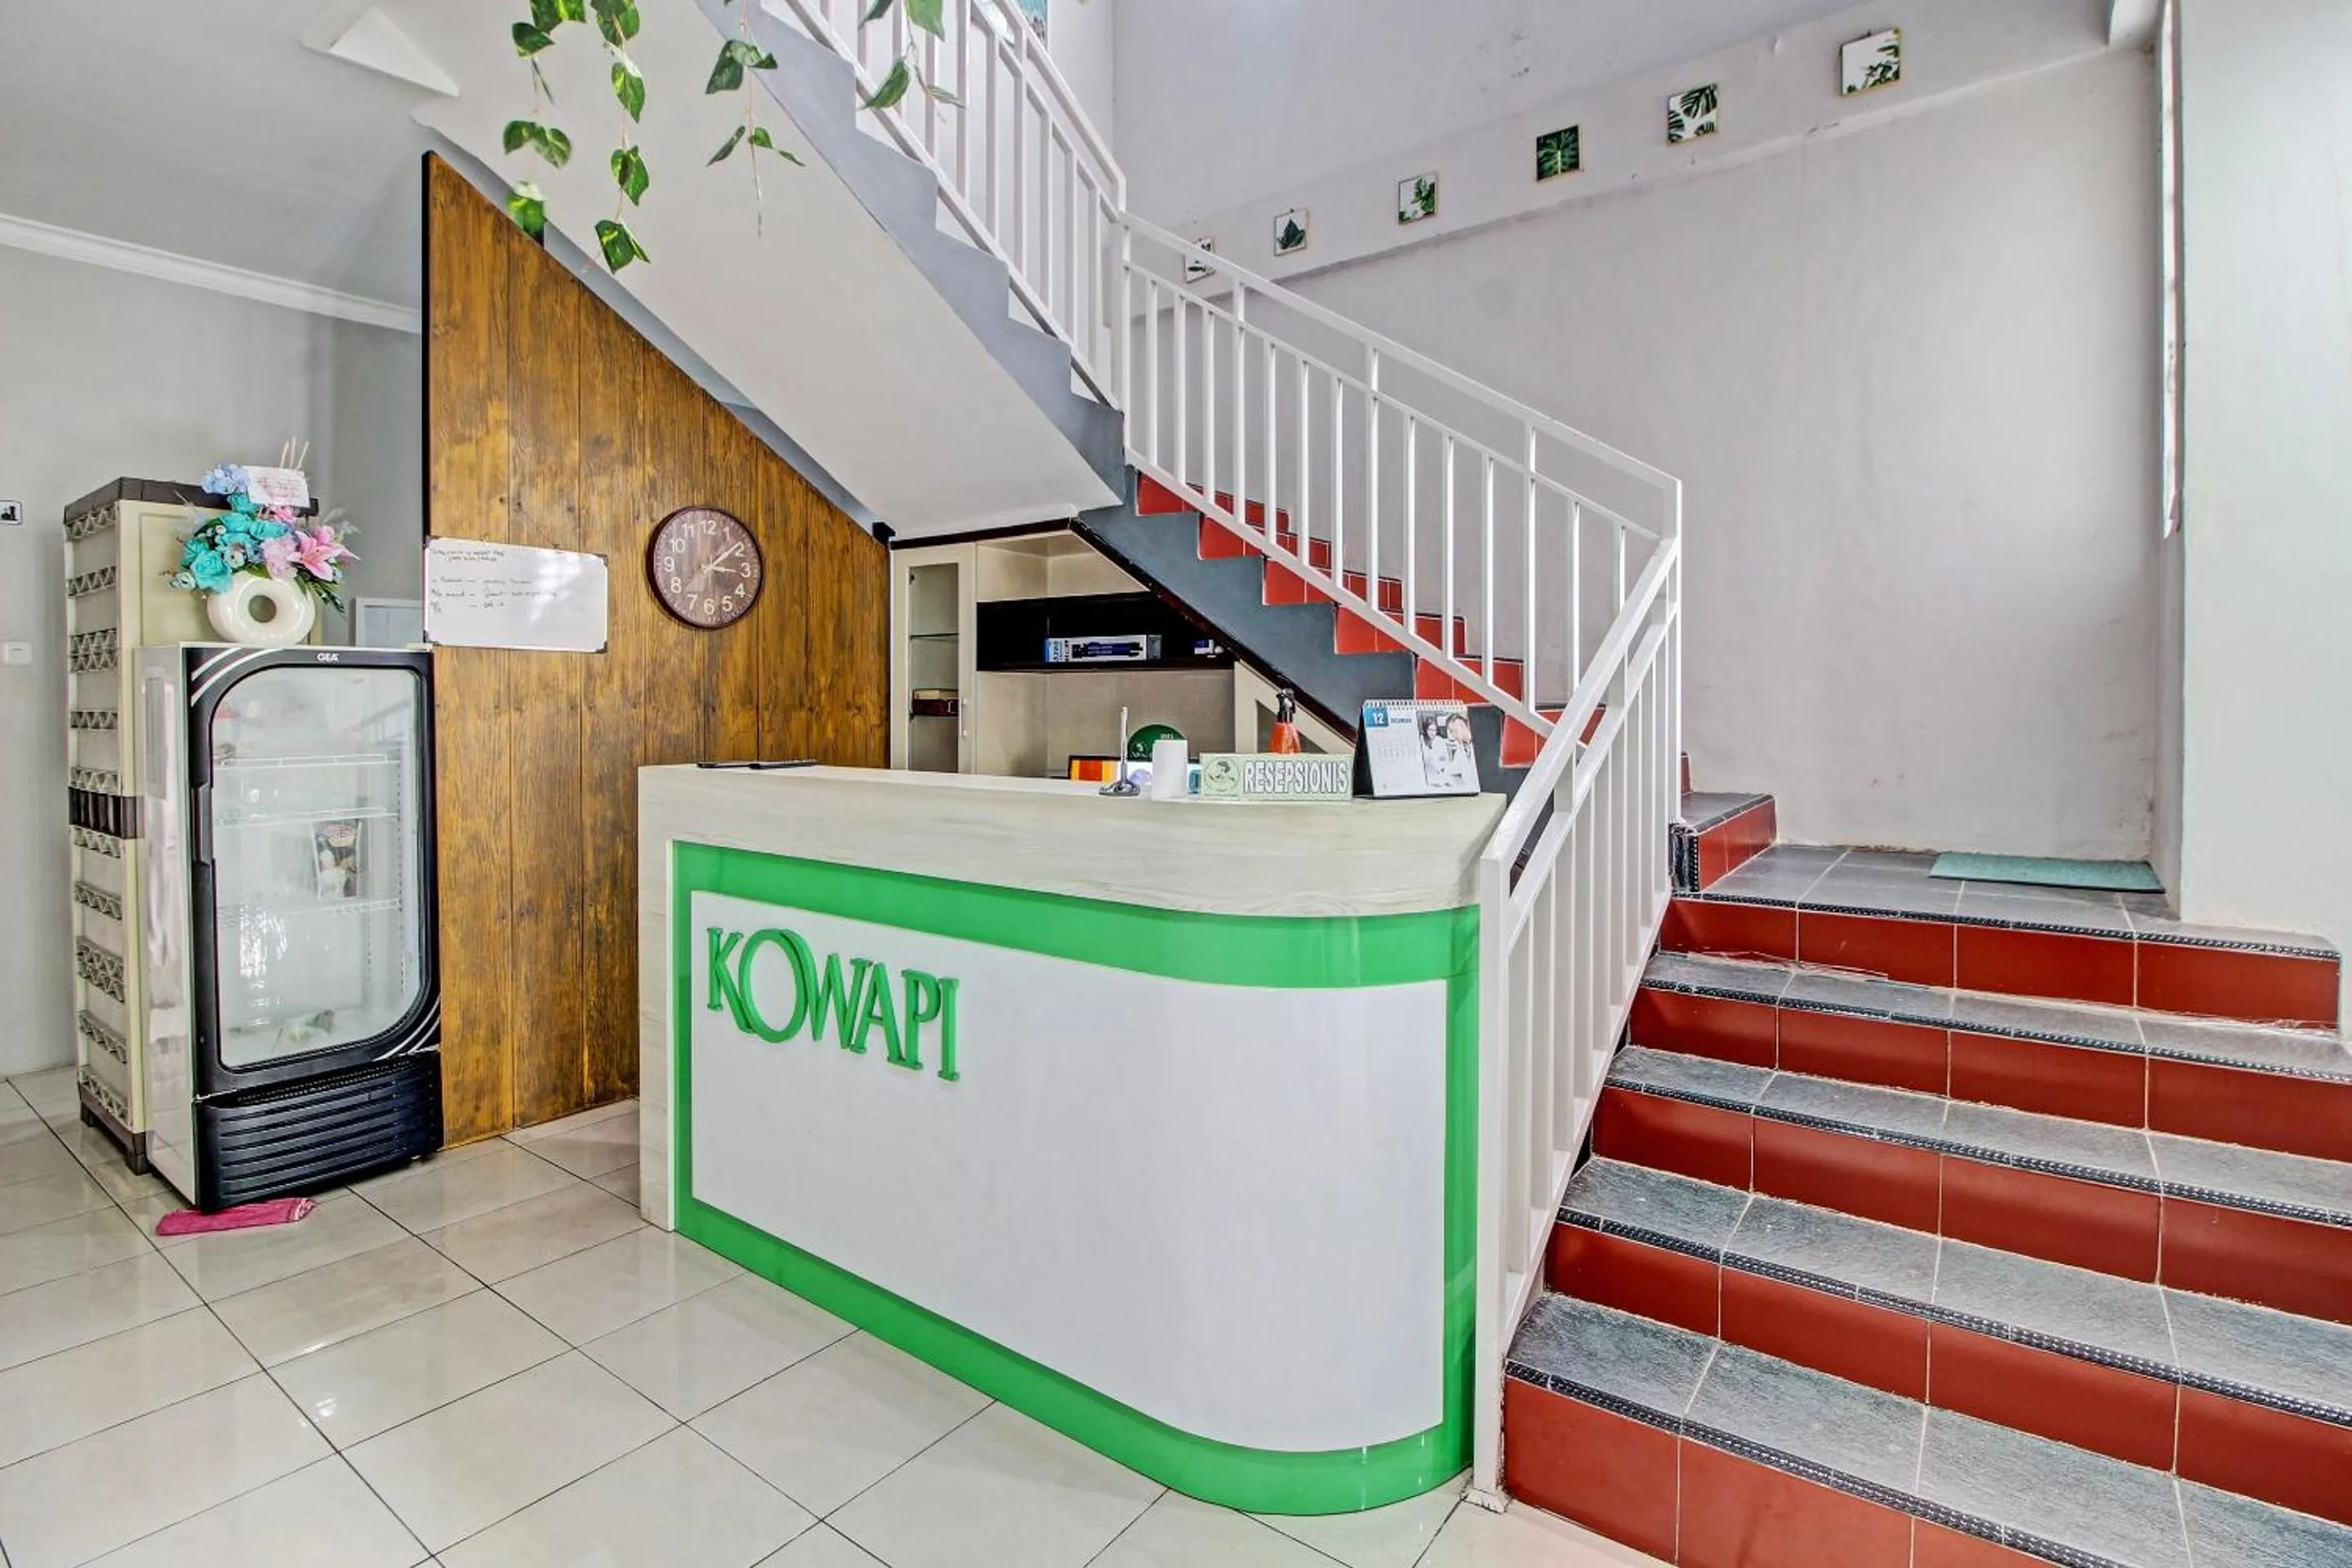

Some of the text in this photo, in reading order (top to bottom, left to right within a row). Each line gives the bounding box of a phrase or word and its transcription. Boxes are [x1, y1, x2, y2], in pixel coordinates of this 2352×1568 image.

[682, 523, 694, 537] 11
[701, 519, 716, 535] 12
[724, 527, 730, 540] 1
[670, 538, 685, 553] 10
[735, 542, 746, 557] 2
[663, 556, 675, 572] 9
[741, 563, 751, 578] 3
[670, 577, 681, 594] 8
[735, 582, 746, 598] 4
[687, 594, 698, 611] 7
[703, 598, 715, 615] 6
[722, 595, 733, 612] 5
[317, 653, 340, 662] GEA
[1372, 713, 1384, 724] 12
[1244, 760, 1348, 794] RESEPSIONIS
[706, 926, 960, 1082] KOWAPI
